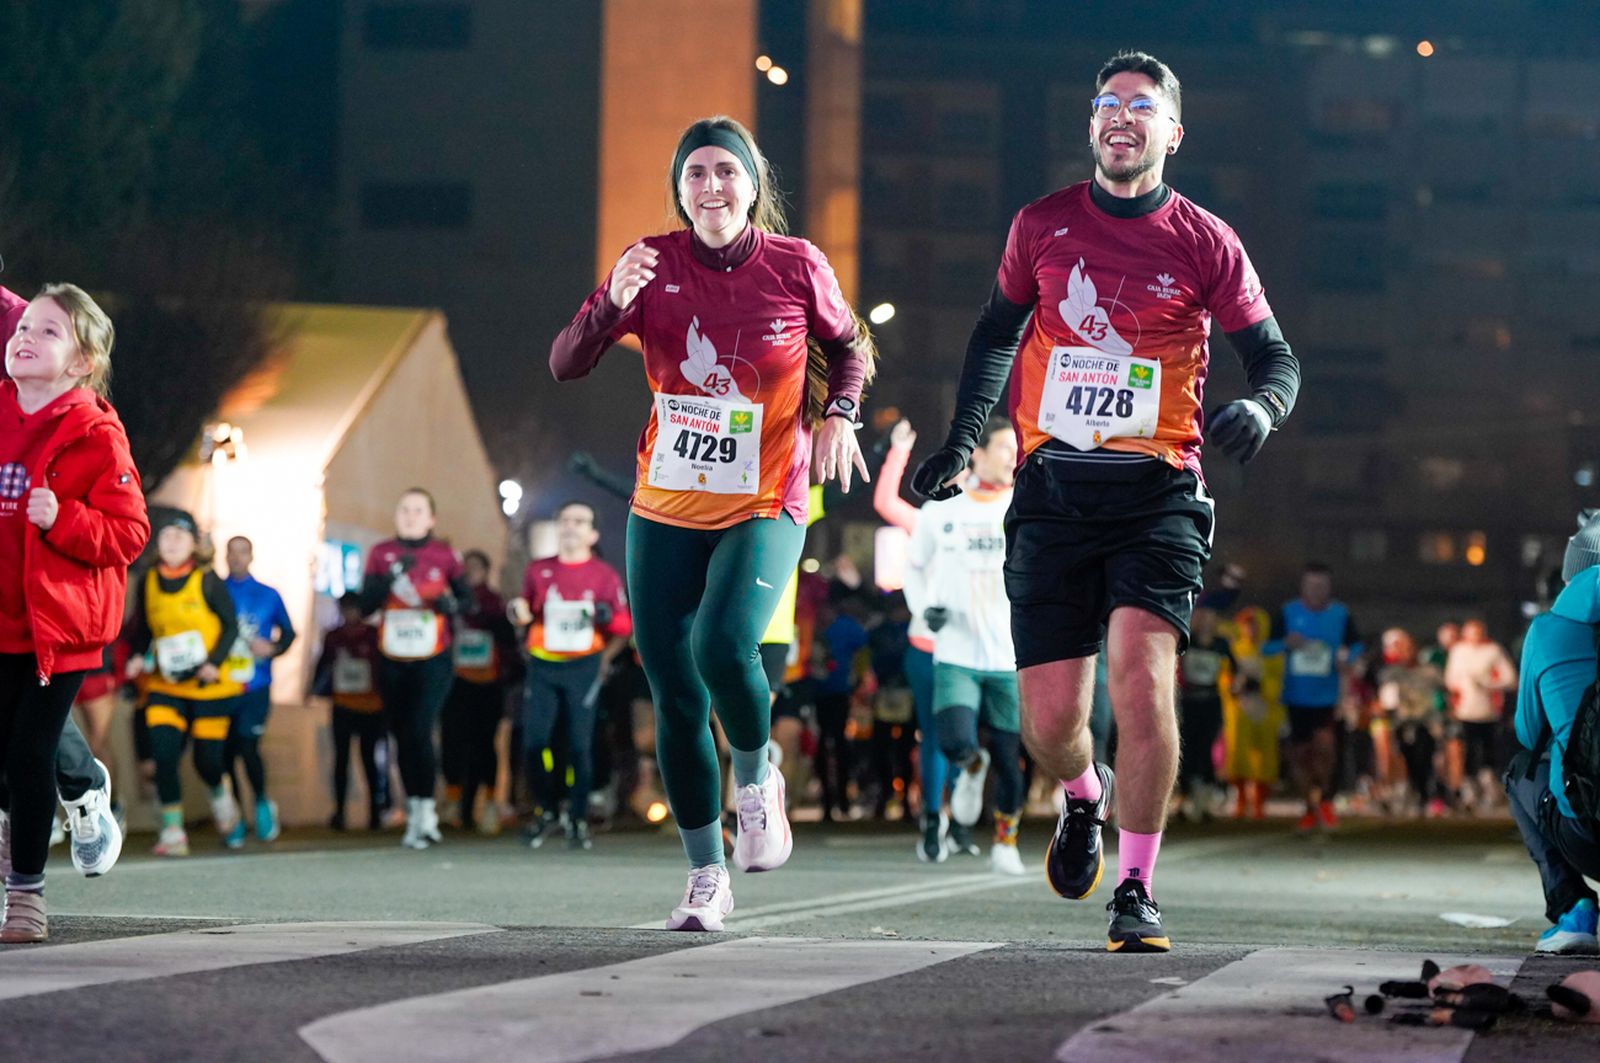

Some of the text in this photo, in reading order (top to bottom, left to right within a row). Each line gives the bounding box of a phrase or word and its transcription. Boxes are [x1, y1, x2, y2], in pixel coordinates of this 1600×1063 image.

[1078, 314, 1108, 341] 43
[1071, 359, 1104, 371] NOCHE
[1106, 362, 1120, 372] DE
[703, 372, 731, 396] 43
[1058, 371, 1080, 383] SAN
[1081, 371, 1119, 385] ANTÓN
[1065, 385, 1135, 419] 4728
[680, 404, 708, 418] NOCHE
[709, 410, 722, 421] DE
[669, 413, 689, 427] SAN
[689, 417, 720, 434] ANTÓN
[1085, 418, 1110, 428] Alberto
[672, 429, 738, 464] 4729
[691, 463, 714, 472] Noelia
